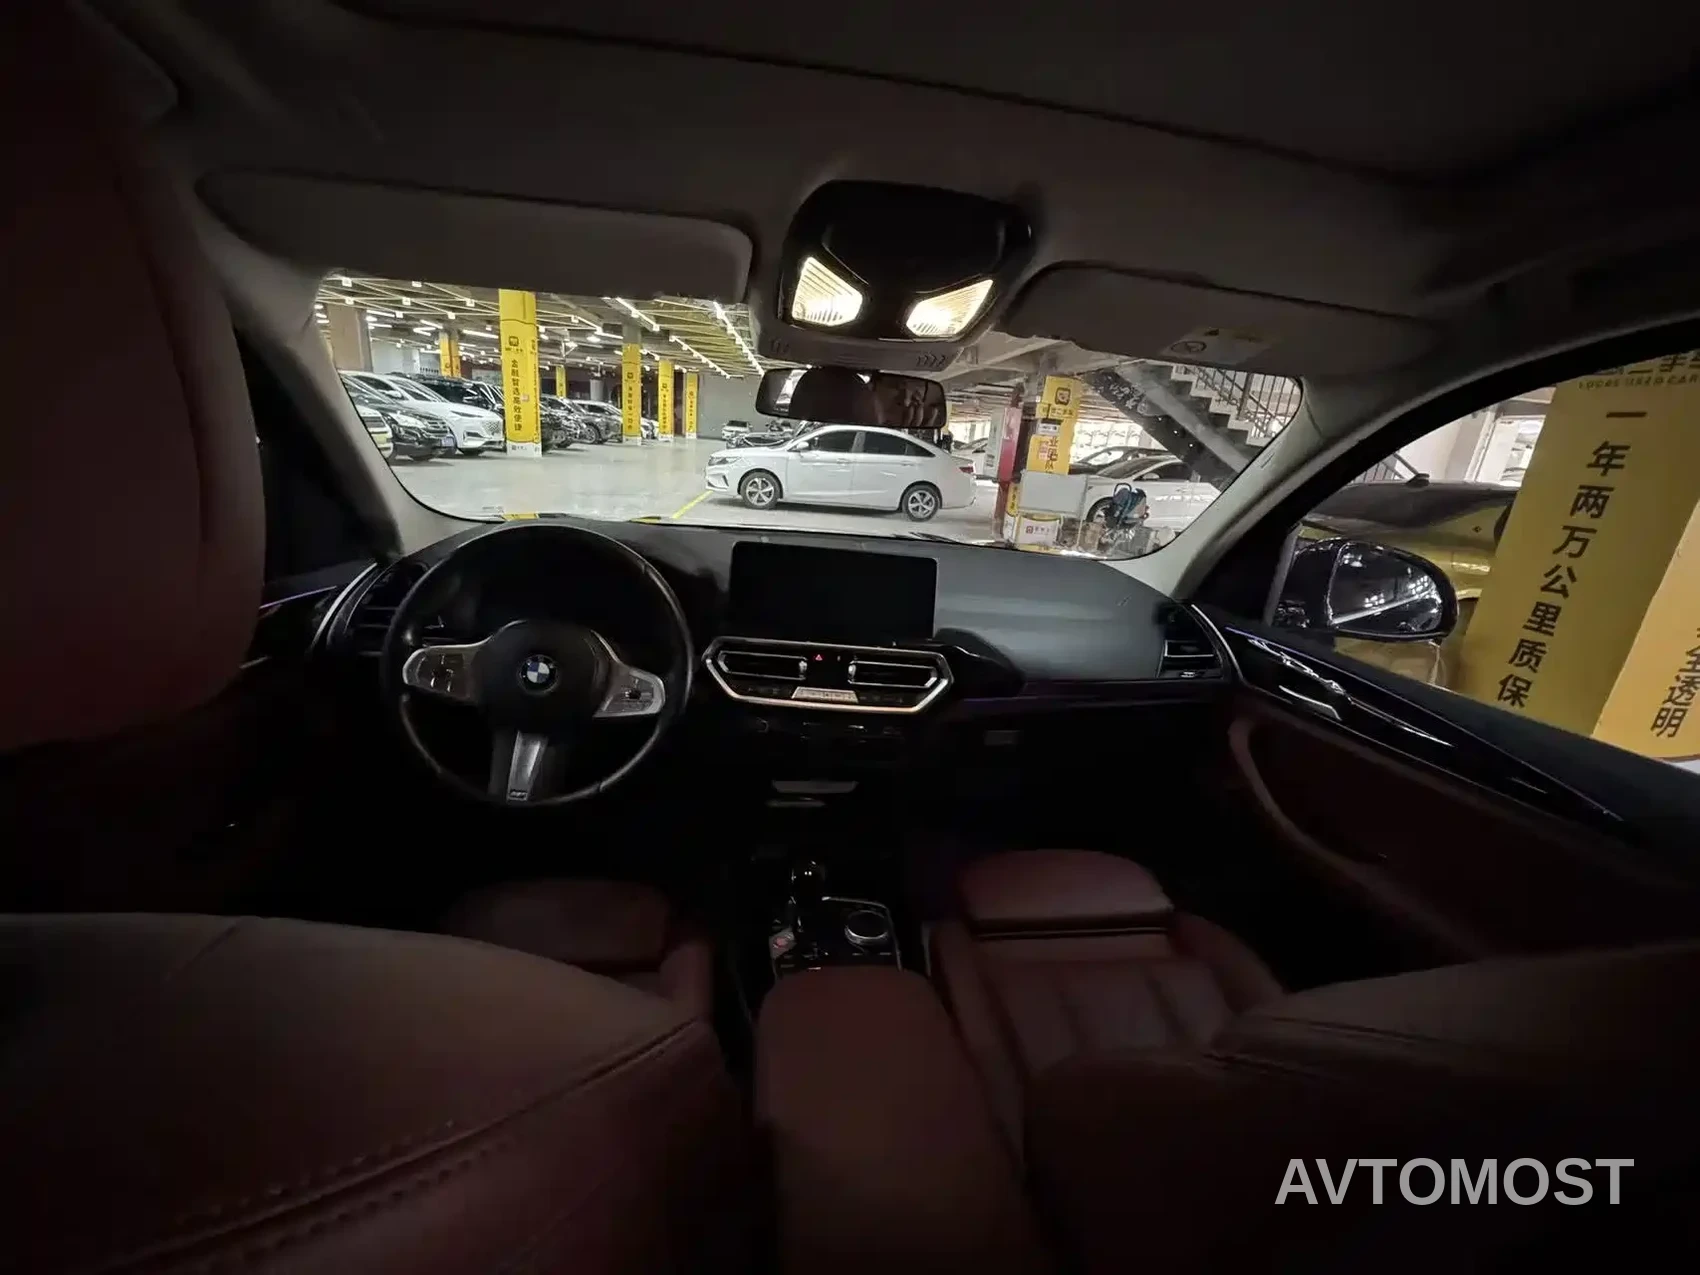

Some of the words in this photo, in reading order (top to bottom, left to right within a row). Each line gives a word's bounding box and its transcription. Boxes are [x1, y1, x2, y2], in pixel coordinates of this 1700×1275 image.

[1497, 411, 1648, 708] 一年两万公里质保
[1651, 628, 1700, 738] 全透明
